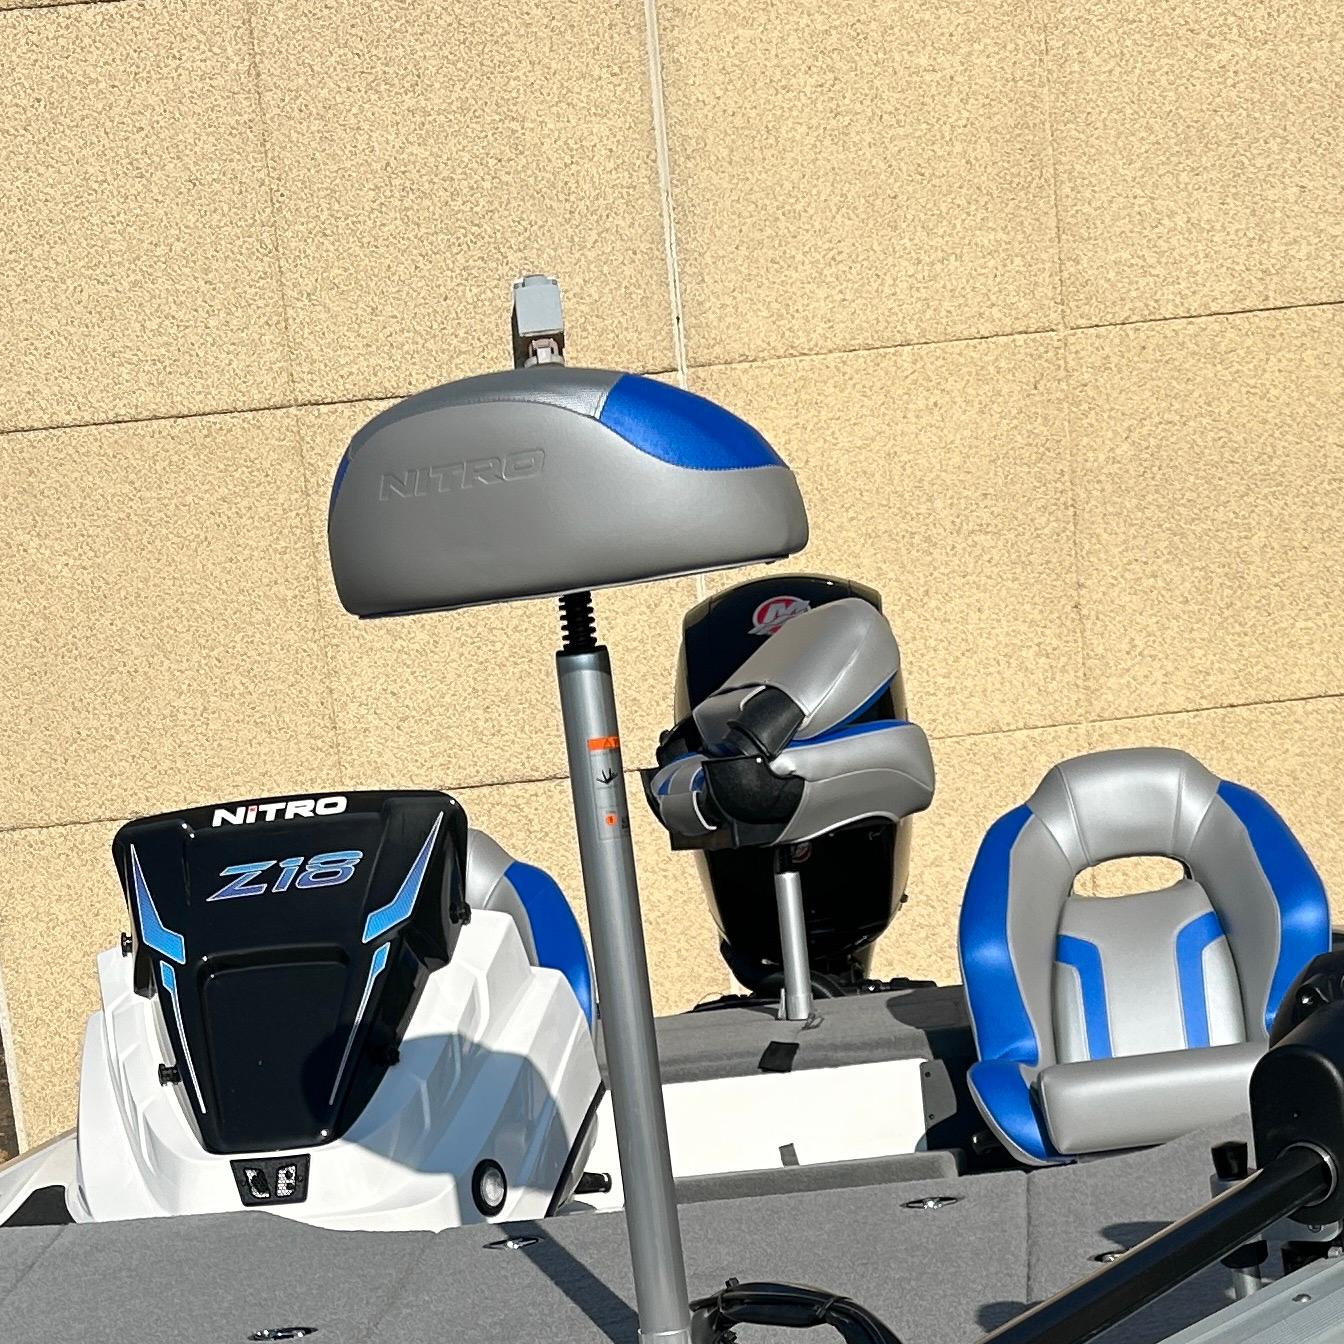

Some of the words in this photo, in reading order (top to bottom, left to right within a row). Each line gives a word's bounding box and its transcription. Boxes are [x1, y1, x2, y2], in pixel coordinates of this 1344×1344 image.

[378, 447, 546, 502] NITRO
[211, 795, 348, 828] NITRO
[206, 849, 364, 902] Z18
